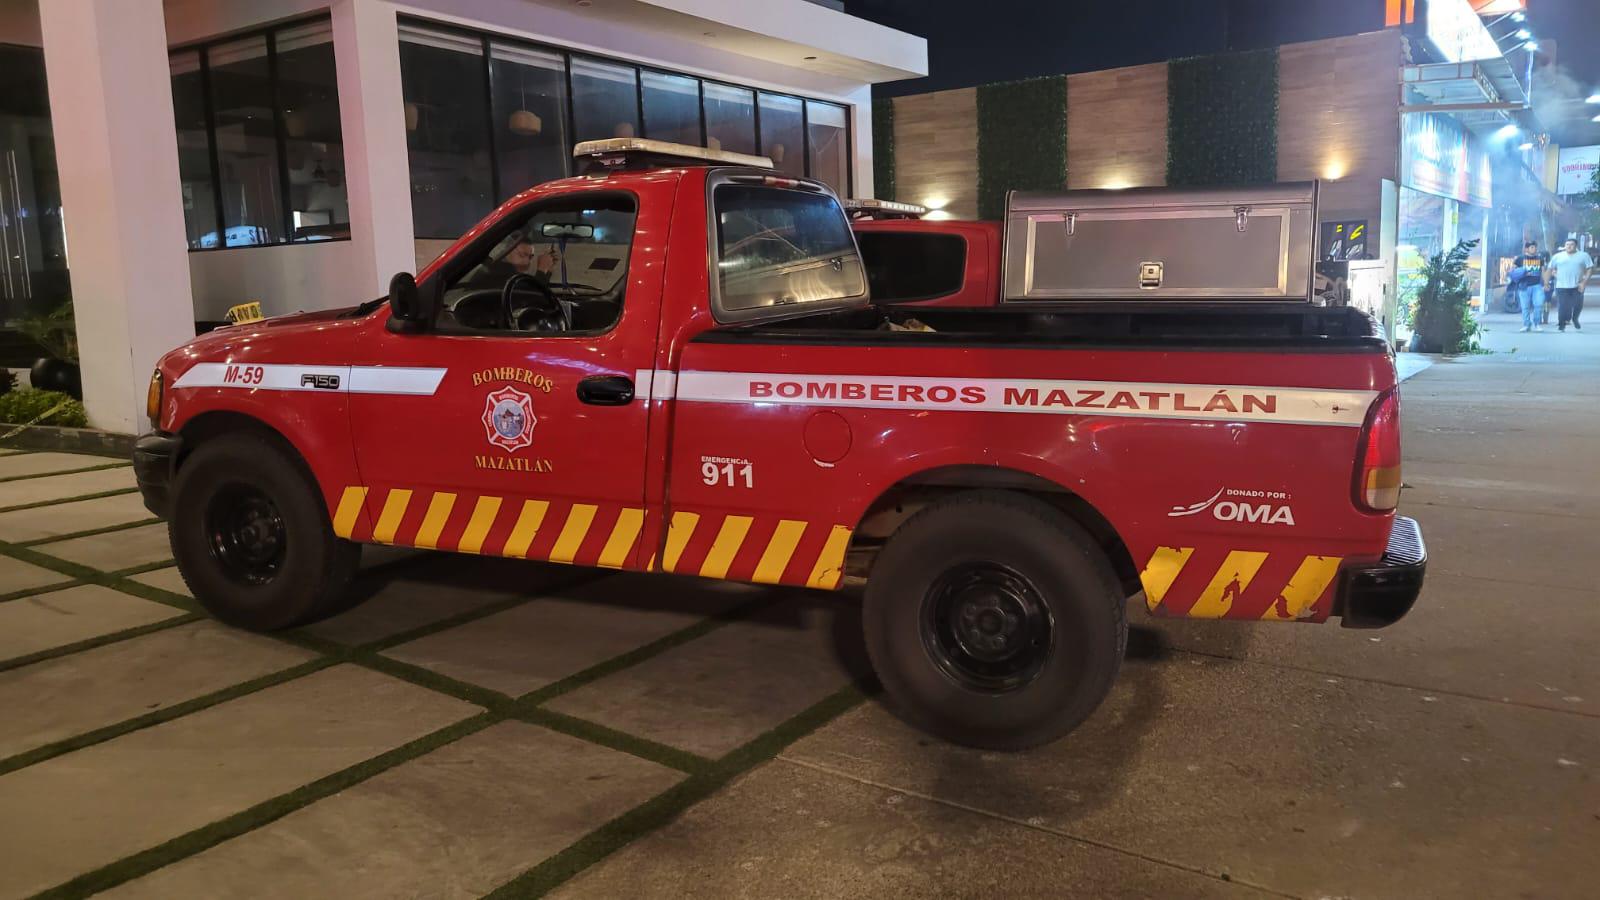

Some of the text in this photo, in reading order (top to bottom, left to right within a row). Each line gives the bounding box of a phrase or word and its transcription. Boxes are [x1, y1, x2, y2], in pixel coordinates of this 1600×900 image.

[224, 366, 264, 385] M-59
[472, 366, 553, 393] BOMBEROS
[750, 382, 1277, 413] BOMBEROS MAZATLÁN
[702, 462, 753, 488] 911
[1227, 489, 1264, 498] DONADO
[1213, 501, 1295, 526] OMA
